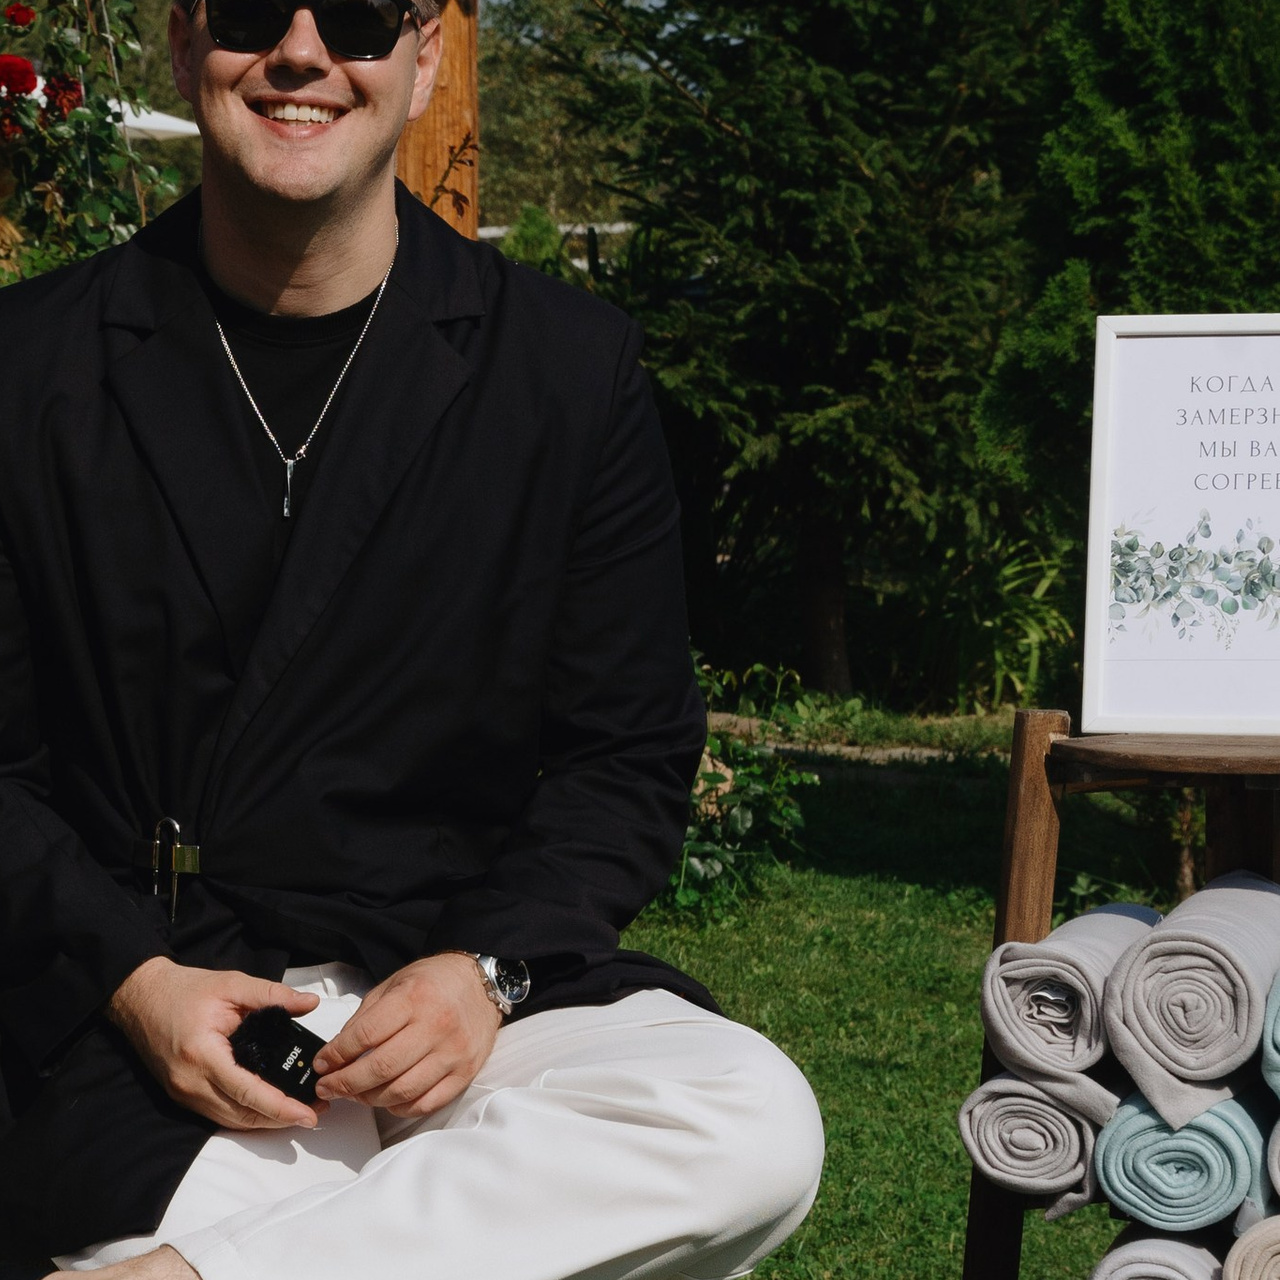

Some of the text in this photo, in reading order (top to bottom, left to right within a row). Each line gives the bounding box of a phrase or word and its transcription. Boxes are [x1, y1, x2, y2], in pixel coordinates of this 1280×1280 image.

[1190, 375, 1274, 393] КОГДА
[1200, 440, 1237, 458] МЫ
[282, 1045, 302, 1071] RØDE
